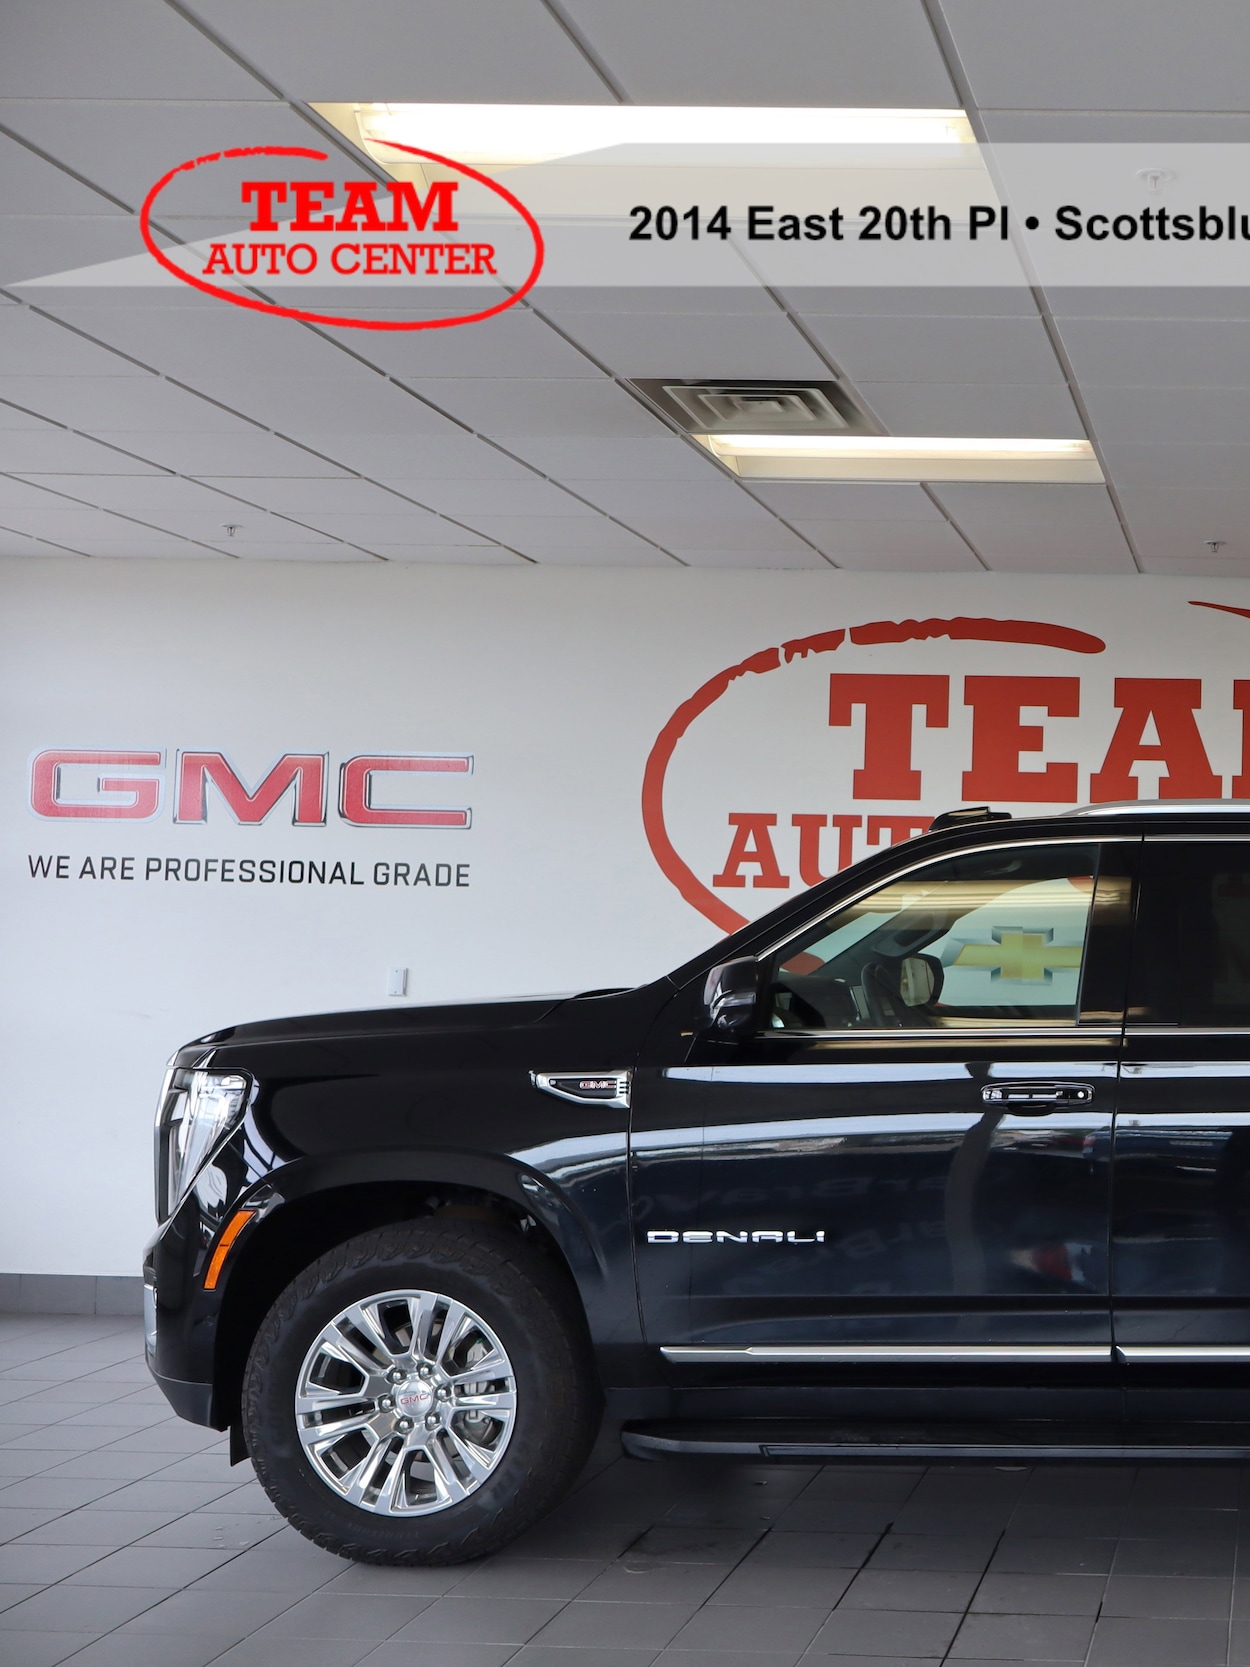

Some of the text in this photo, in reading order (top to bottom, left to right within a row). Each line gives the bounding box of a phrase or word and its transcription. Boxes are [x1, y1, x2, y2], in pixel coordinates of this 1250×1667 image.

[27, 747, 474, 829] GMC
[712, 812, 935, 889] AUT
[28, 854, 470, 887] WE ARE PROFESSIONAL GRADE
[579, 1080, 617, 1090] GMC
[646, 1230, 826, 1244] DENALI
[400, 1393, 430, 1405] GMC
